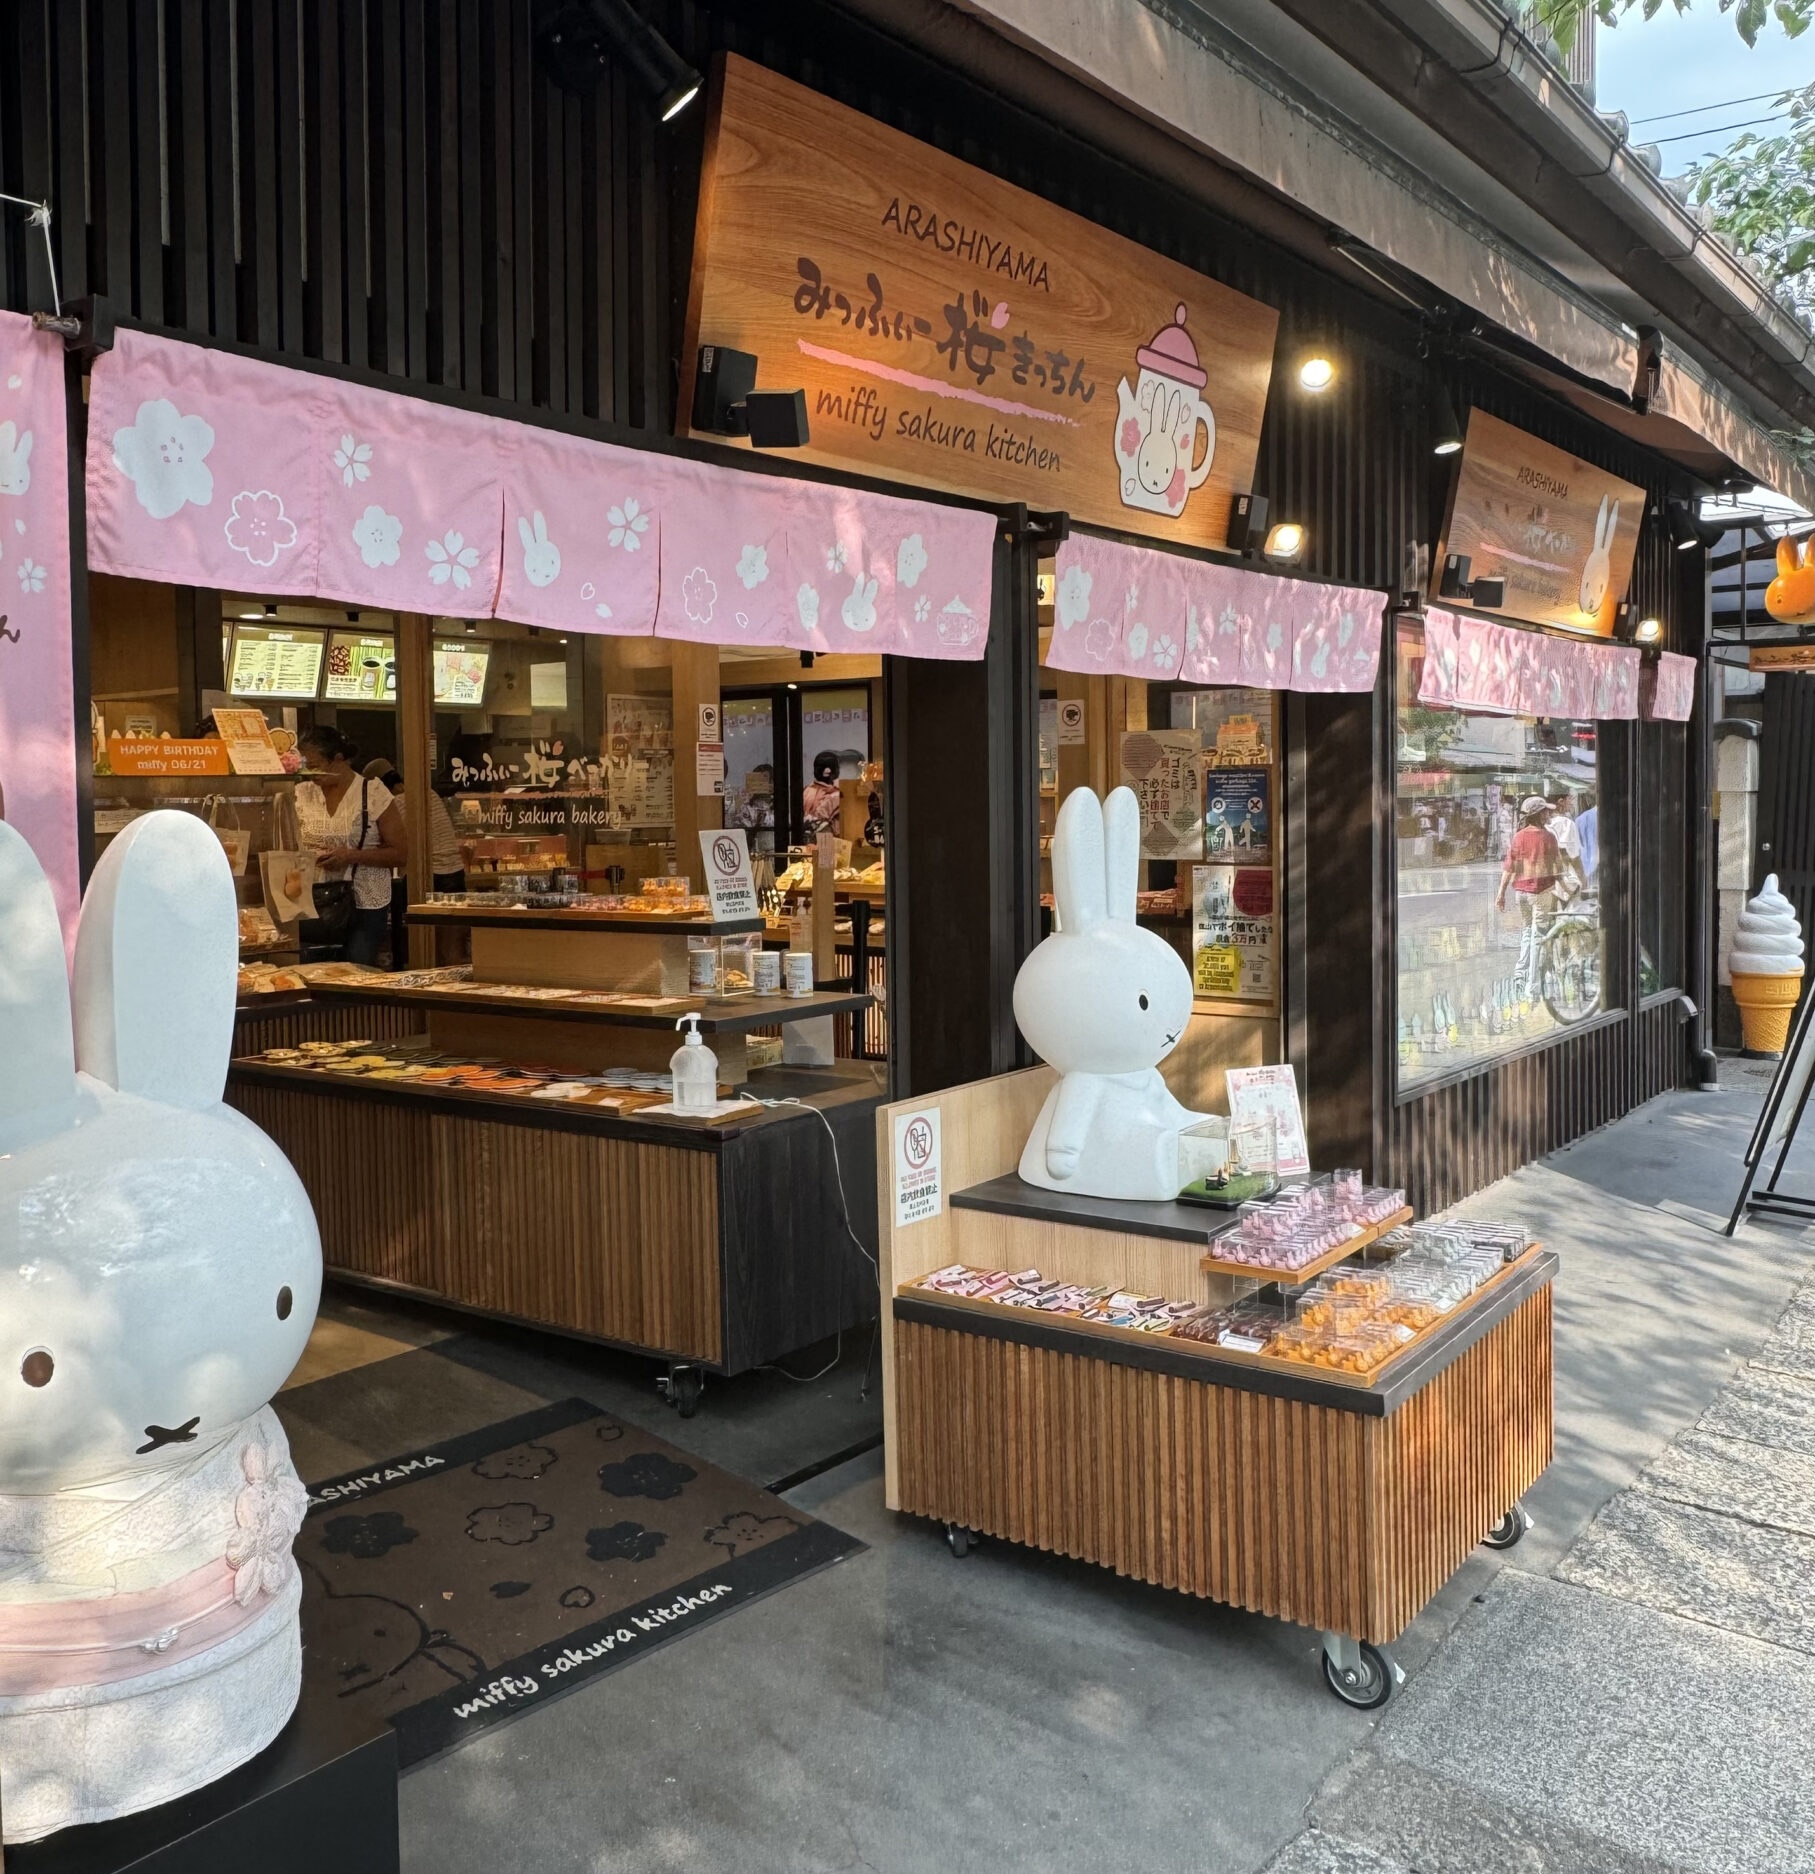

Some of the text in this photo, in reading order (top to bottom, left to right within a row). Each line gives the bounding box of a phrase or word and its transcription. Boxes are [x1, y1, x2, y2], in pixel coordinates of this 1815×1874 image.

[881, 197, 1051, 293] ARASHIYAMA
[794, 257, 1096, 403] みっふぃー桜きっちん
[816, 387, 1062, 473] miffy sakura kitchen
[120, 745, 219, 757] HAPPY BIRTHDAY
[137, 759, 206, 772] miffy 06/21
[478, 804, 622, 830] miffy sakura bakery
[453, 1582, 732, 1719] miffy sakura kitchen
